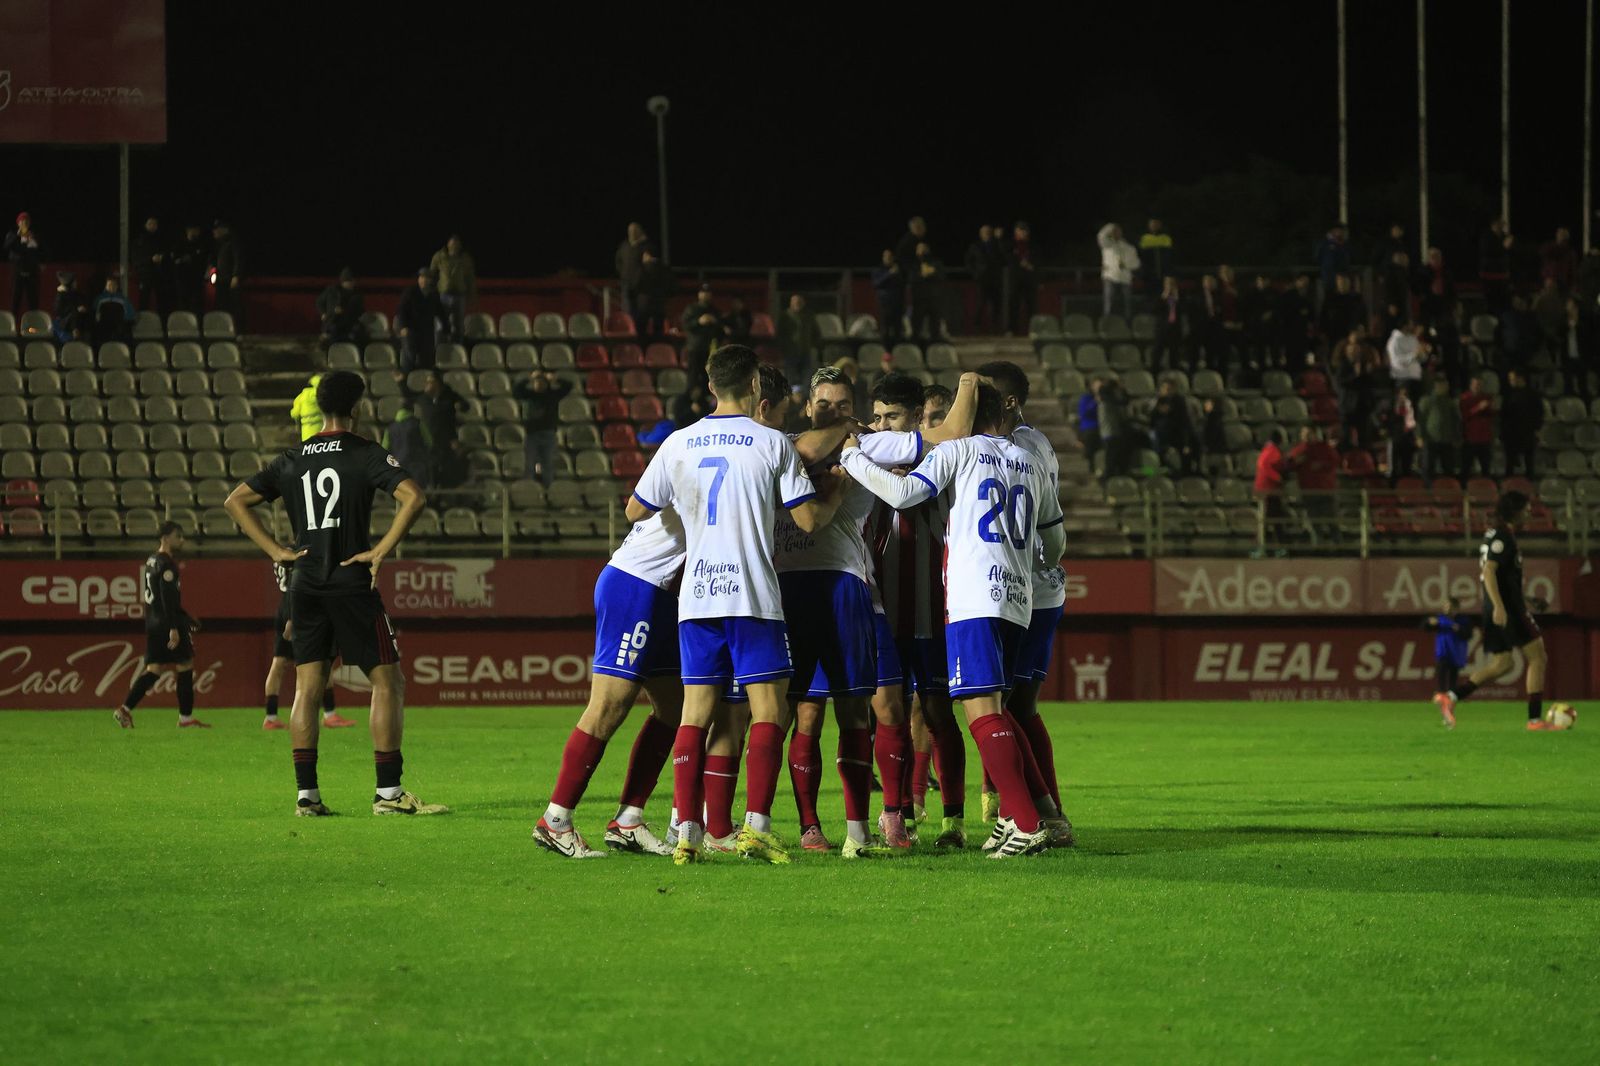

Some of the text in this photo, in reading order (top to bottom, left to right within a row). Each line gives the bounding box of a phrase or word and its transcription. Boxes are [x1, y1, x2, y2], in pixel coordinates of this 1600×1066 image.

[301, 440, 343, 456] MIGUEL
[686, 433, 754, 450] RASTROJO
[301, 467, 341, 531] 12
[698, 456, 730, 526] 7
[977, 477, 1034, 550] 20
[21, 565, 147, 614] capel
[394, 565, 494, 591] FÚTBL
[709, 577, 740, 597] Gusta
[1178, 564, 1352, 609] Adecco
[1382, 564, 1555, 610] Adeo
[94, 604, 144, 619] SPO
[630, 620, 650, 650] 6
[0, 640, 223, 697] Casa Maé
[413, 655, 592, 684] SEA&PO
[1194, 643, 1340, 682] ELEAL
[1354, 640, 1436, 682] S.L.
